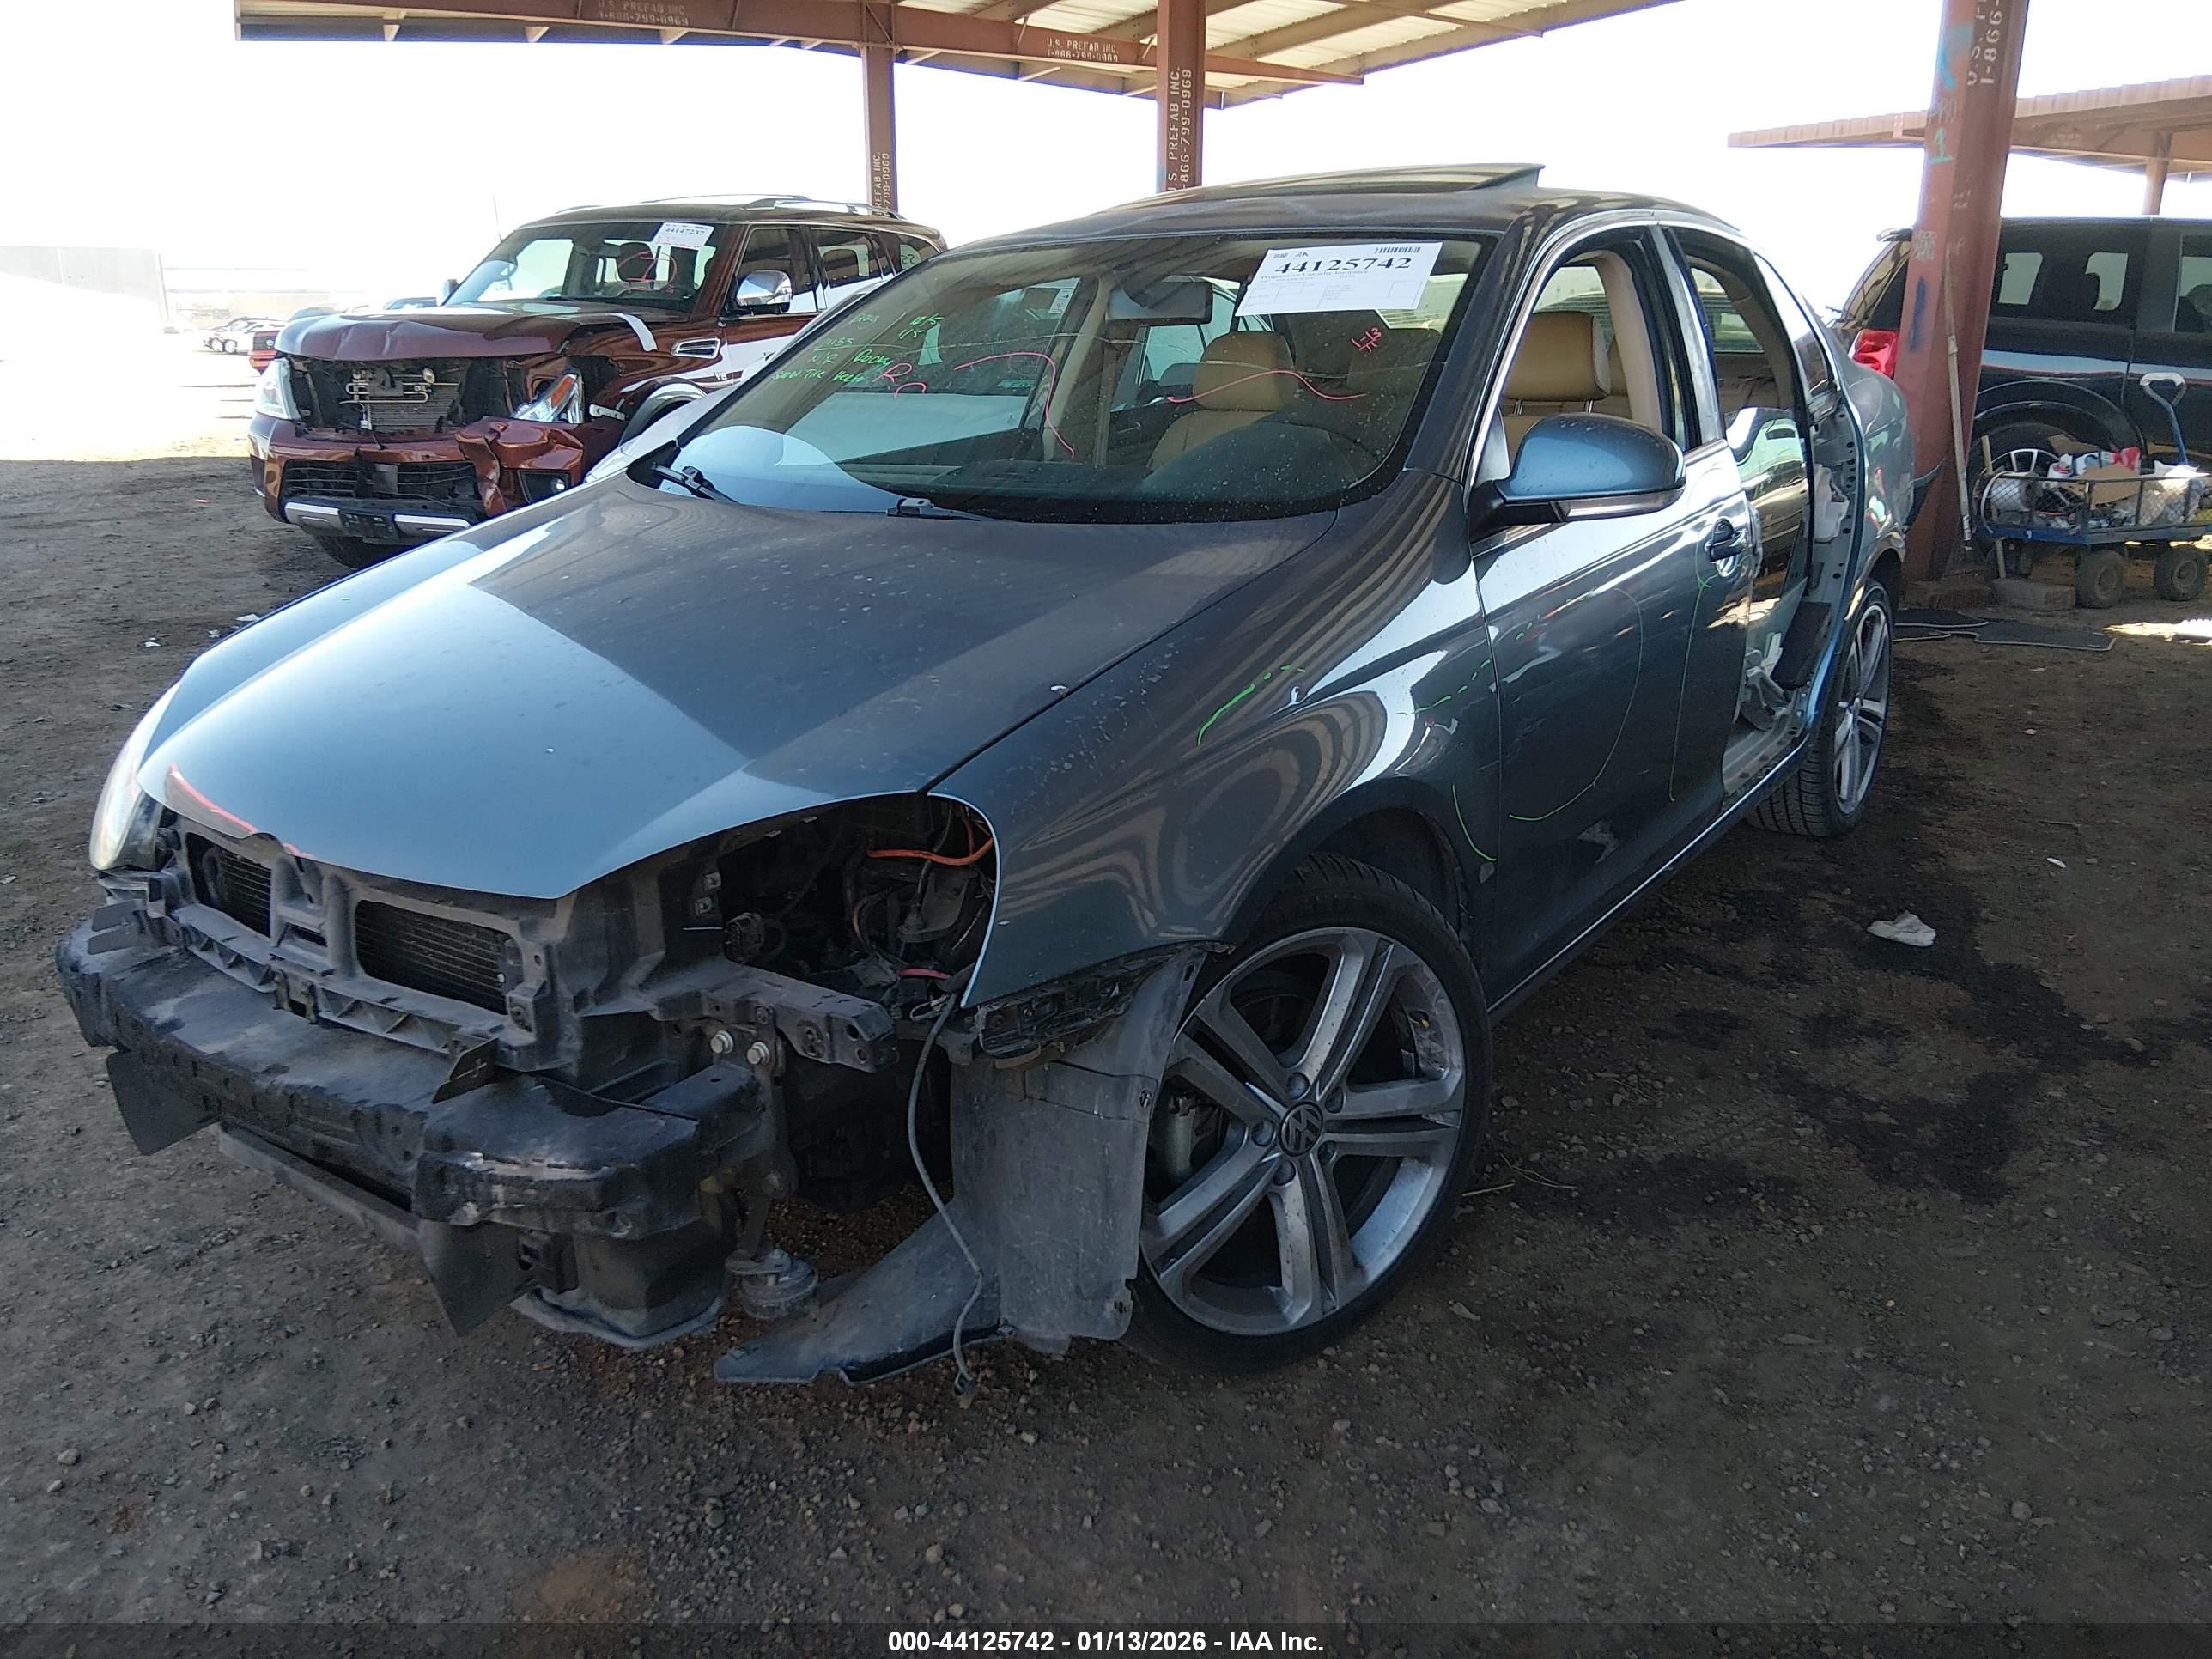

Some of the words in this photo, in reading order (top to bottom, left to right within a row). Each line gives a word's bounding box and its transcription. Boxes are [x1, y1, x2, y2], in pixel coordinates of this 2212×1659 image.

[1066, 40, 1099, 52] PREFAB
[1170, 65, 1181, 95] INC.
[1168, 102, 1180, 161] PREFAB
[1180, 69, 1192, 190] -866-799-0969
[1273, 257, 1413, 274] 44125742
[714, 370, 728, 381] V8
